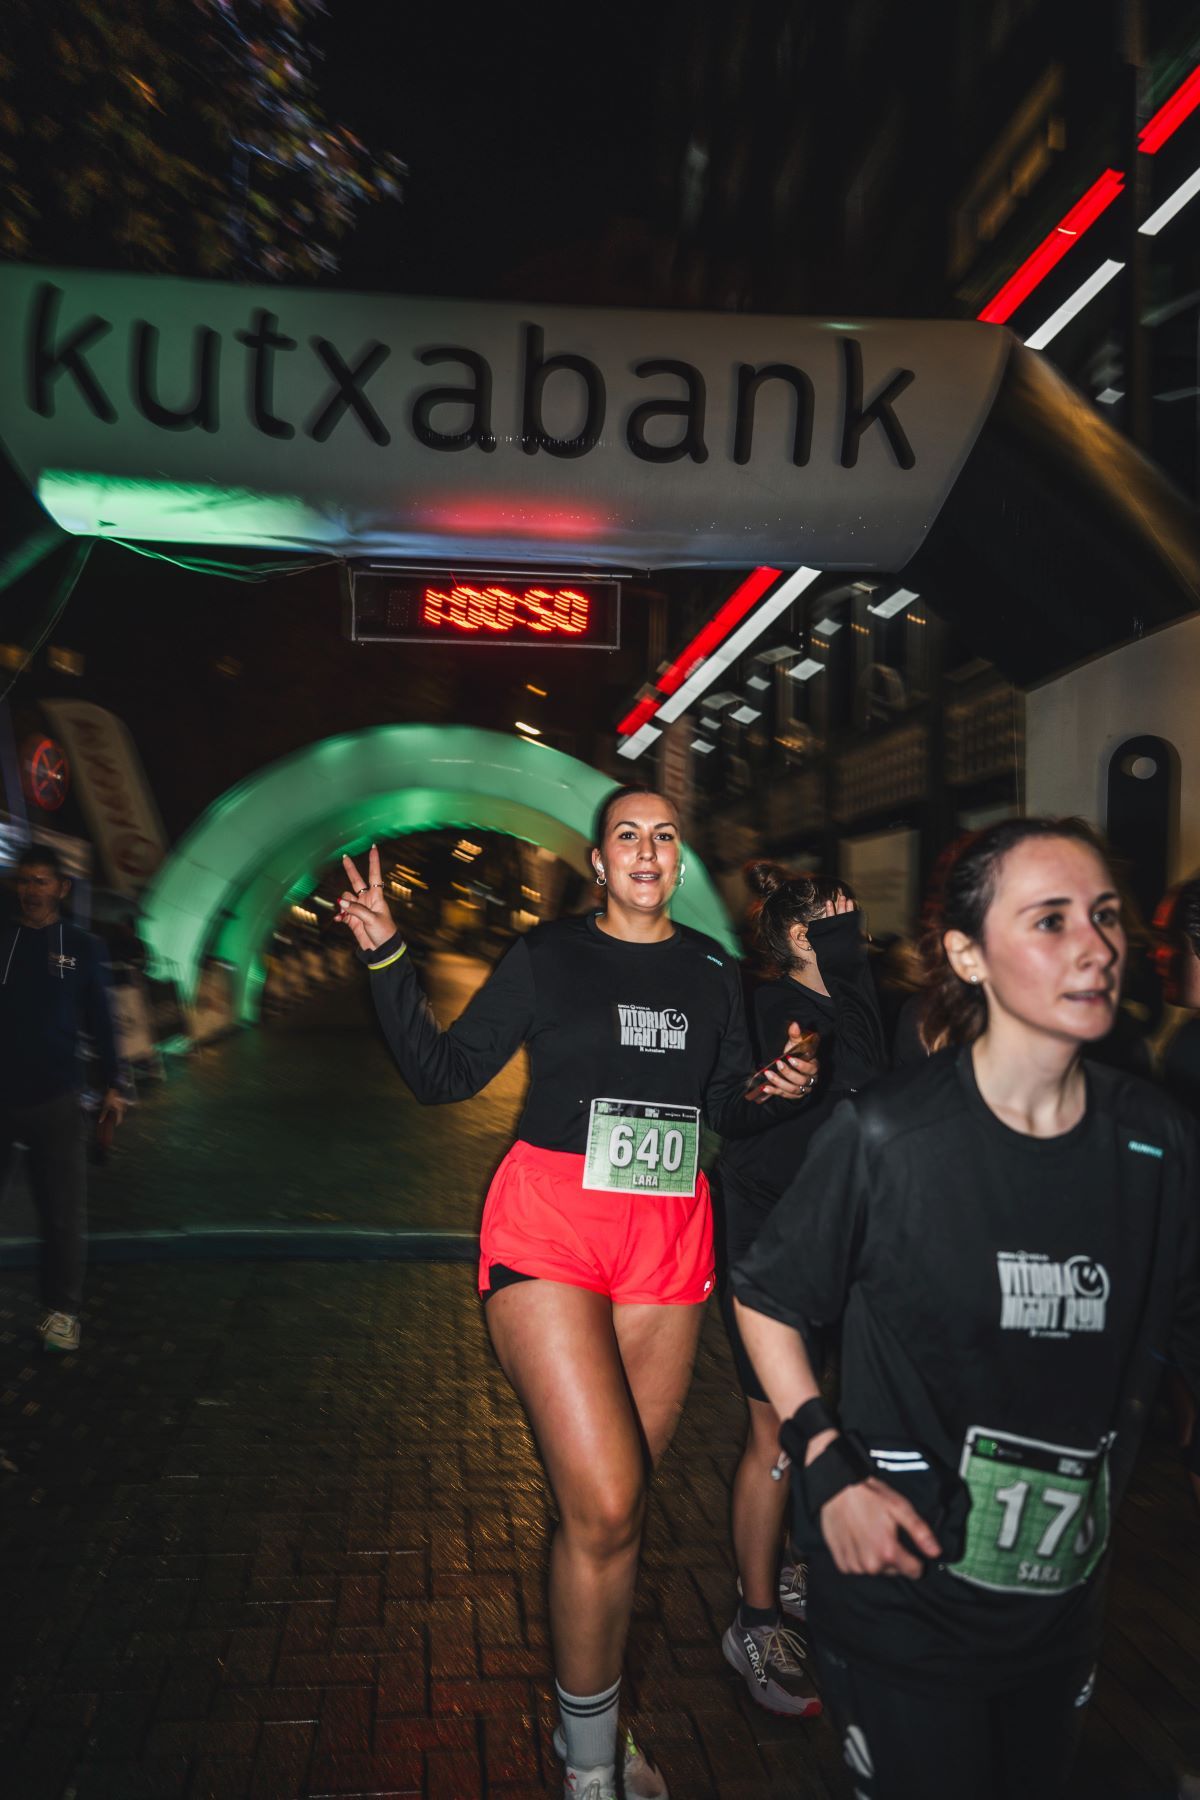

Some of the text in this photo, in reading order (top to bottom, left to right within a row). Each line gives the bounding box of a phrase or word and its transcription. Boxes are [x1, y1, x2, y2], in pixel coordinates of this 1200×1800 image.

[26, 280, 917, 470] kutxabank
[618, 1008, 668, 1030] VITORIA
[621, 1026, 686, 1050] NIGHT RUN
[608, 1124, 684, 1172] 640
[632, 1173, 658, 1187] LARA
[997, 1260, 1076, 1296] VITORIA
